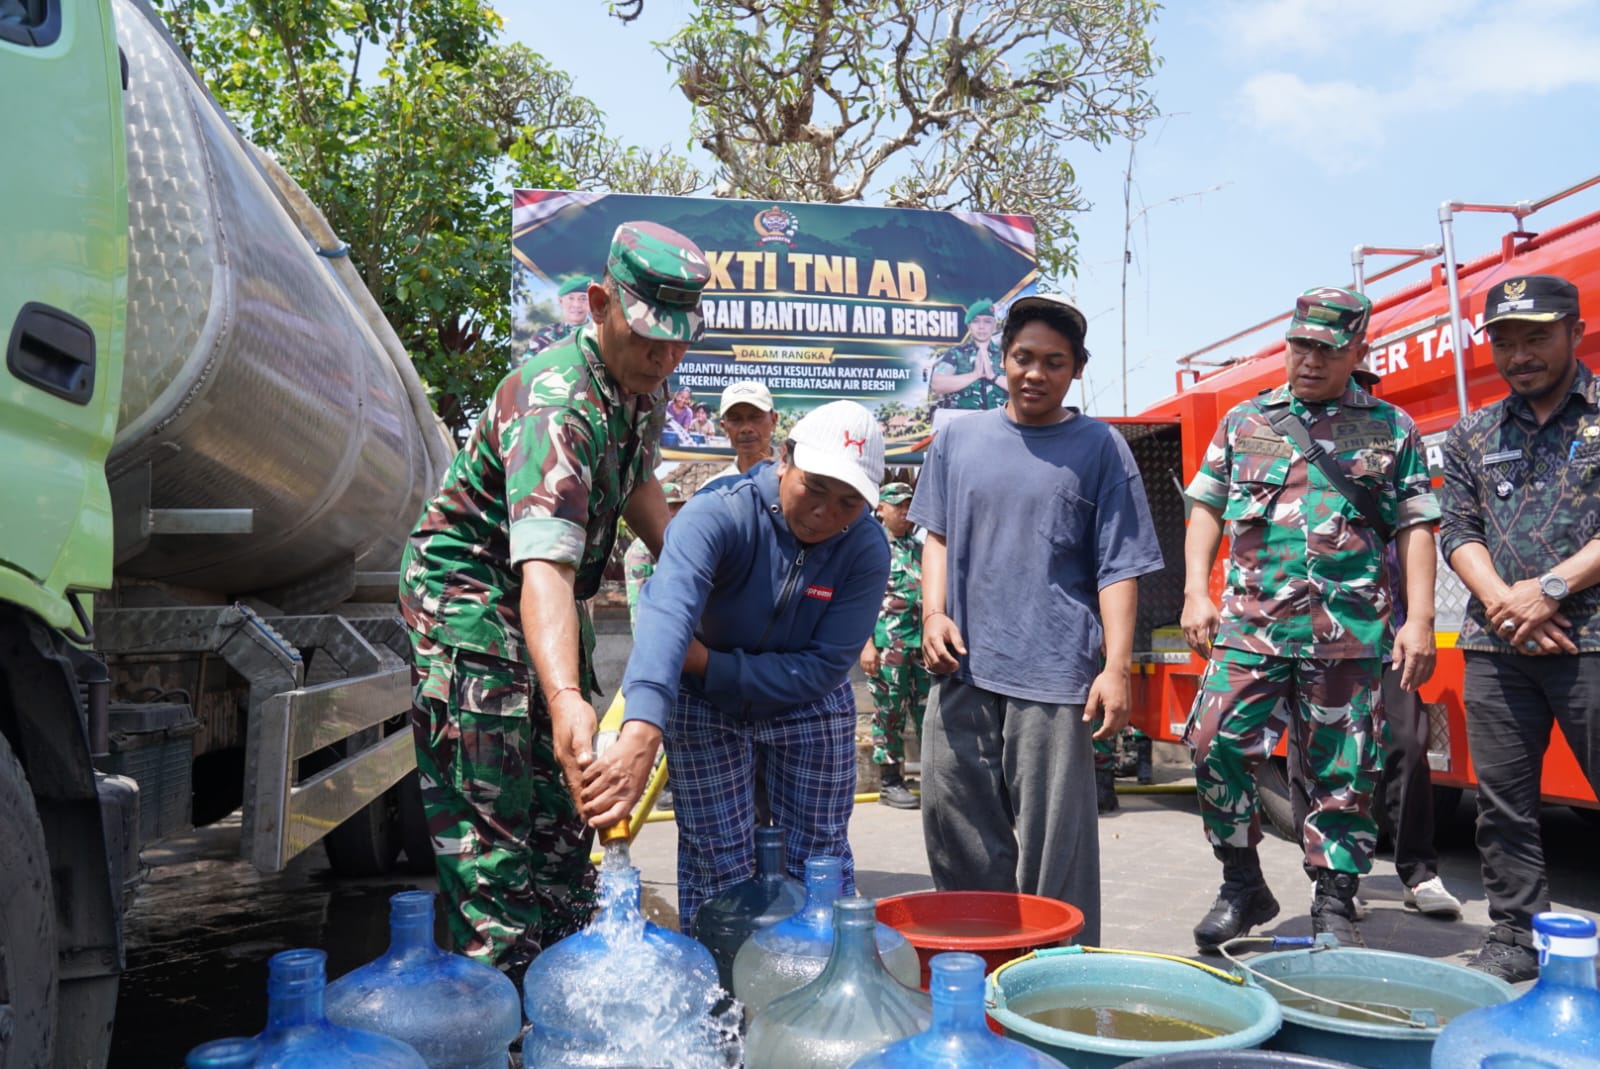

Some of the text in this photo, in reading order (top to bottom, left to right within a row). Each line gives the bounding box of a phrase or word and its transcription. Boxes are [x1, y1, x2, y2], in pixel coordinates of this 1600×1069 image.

[703, 251, 928, 302] KTI TNI AD
[702, 300, 959, 338] RAN BANTUAN AIR BERSIH
[741, 349, 826, 360] DALAM RANGKA
[1370, 313, 1491, 377] ER TAN
[673, 363, 911, 380] MBANTU MENGATASI KESULITAN RAKYAT AKIBAT
[679, 375, 742, 387] KEKERINGAN
[768, 377, 841, 390] KETERBATASAN
[843, 379, 860, 390] AIR
[861, 380, 896, 391] BERSIH
